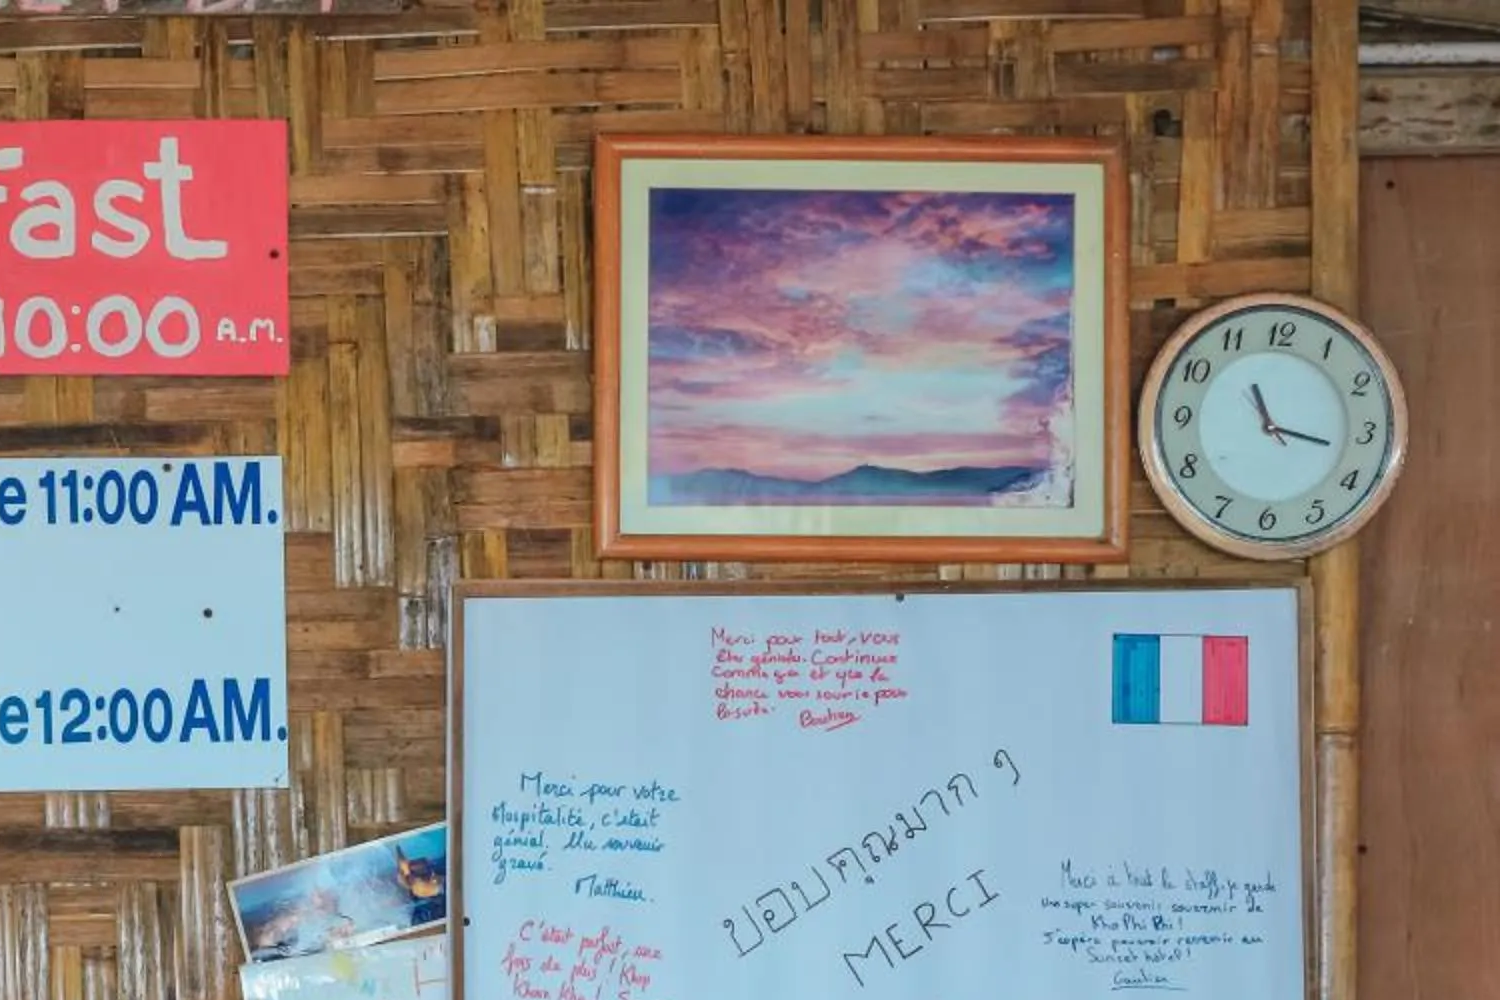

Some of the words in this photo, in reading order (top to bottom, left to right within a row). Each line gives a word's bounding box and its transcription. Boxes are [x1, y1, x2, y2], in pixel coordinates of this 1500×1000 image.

[216, 316, 284, 344] A.M.
[1221, 327, 1244, 352] 11
[1268, 321, 1297, 347] 12
[1323, 336, 1333, 360] 1
[1183, 358, 1211, 384] 10
[1351, 370, 1371, 397] 2
[1173, 405, 1193, 430] 9
[1356, 421, 1377, 446] 3
[1179, 453, 1198, 479] 8
[1340, 469, 1360, 491] 4
[38, 468, 159, 525] 11:00
[170, 461, 279, 527] AM.
[1214, 494, 1234, 519] 7
[1258, 506, 1277, 531] 6
[1305, 499, 1325, 525] 5
[763, 634, 803, 654] pour
[33, 688, 174, 744] 12:00
[179, 677, 290, 743] AM.
[520, 771, 577, 797] Merci
[579, 784, 627, 805] pour
[632, 780, 682, 803] votre
[842, 868, 1001, 988] MERCI
